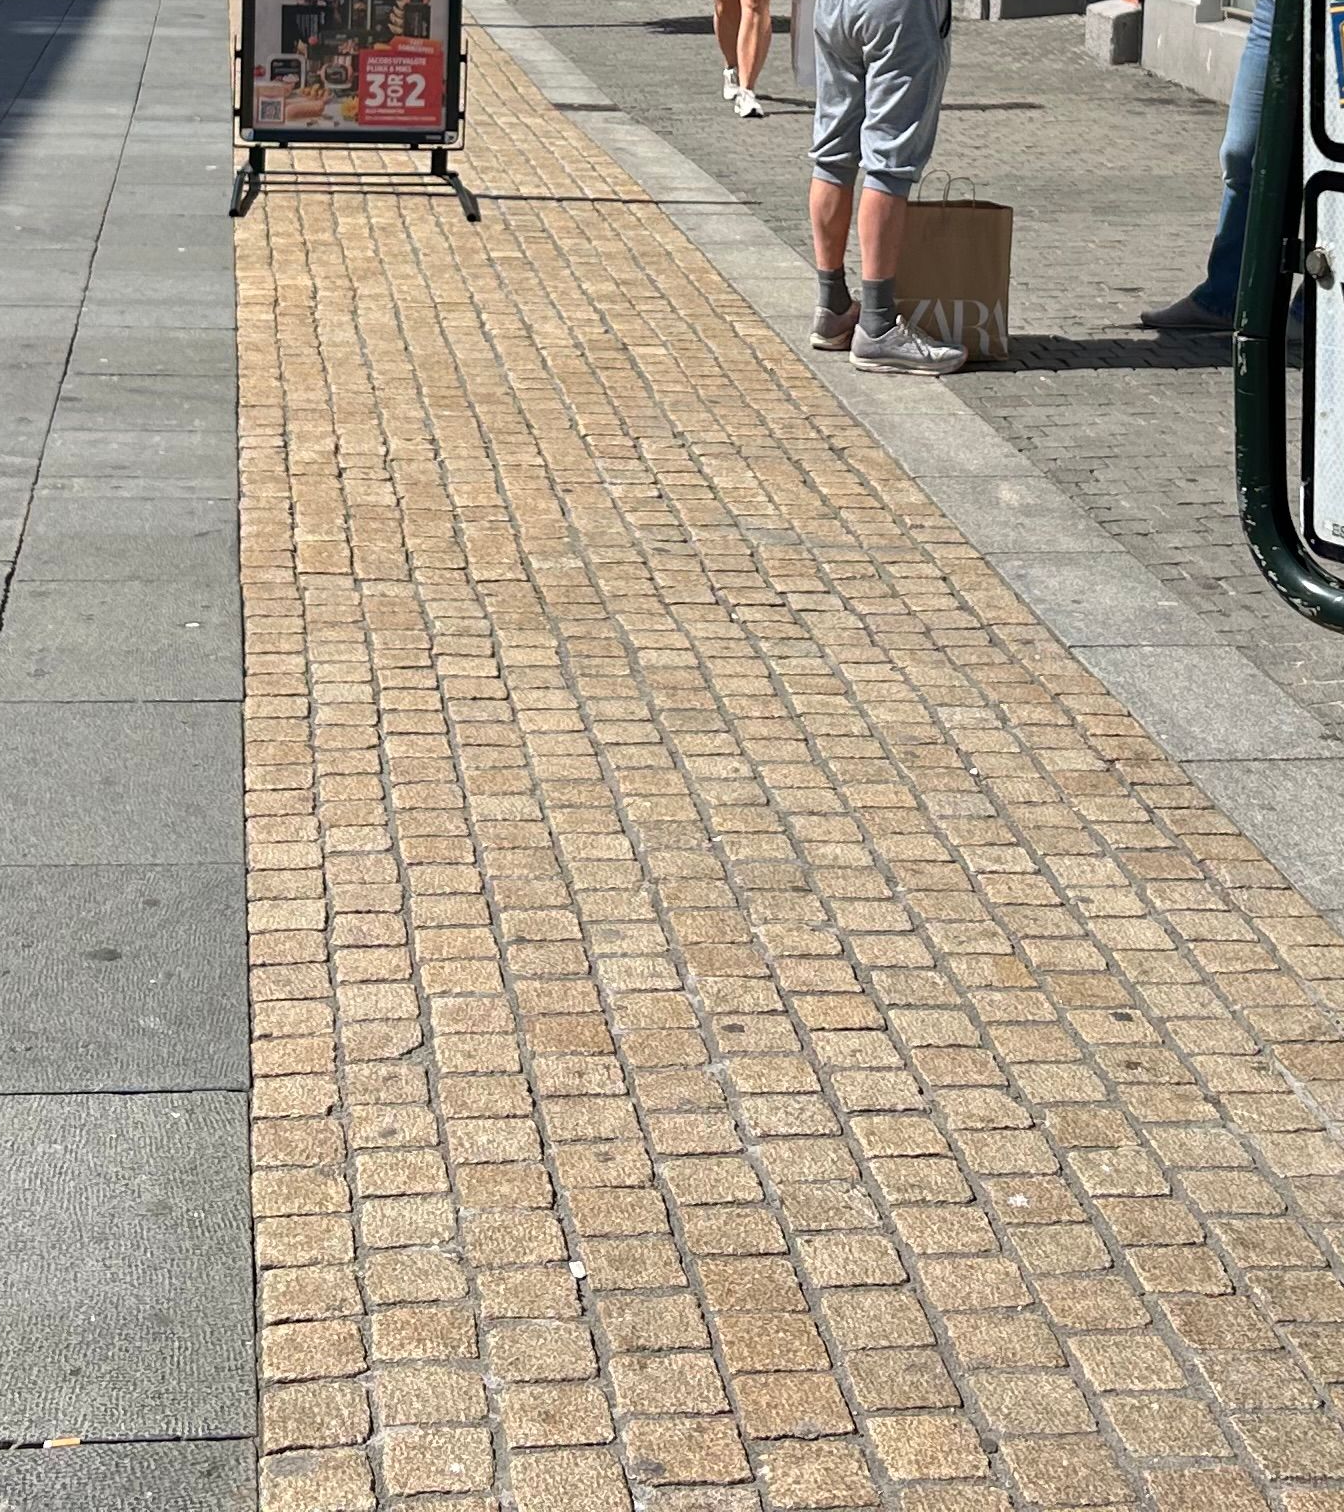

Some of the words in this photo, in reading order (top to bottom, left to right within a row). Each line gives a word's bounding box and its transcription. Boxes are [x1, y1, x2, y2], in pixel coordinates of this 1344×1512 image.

[364, 73, 386, 107] 3
[386, 74, 404, 107] FOR
[405, 73, 426, 107] 2
[892, 298, 1008, 358] ZARA
